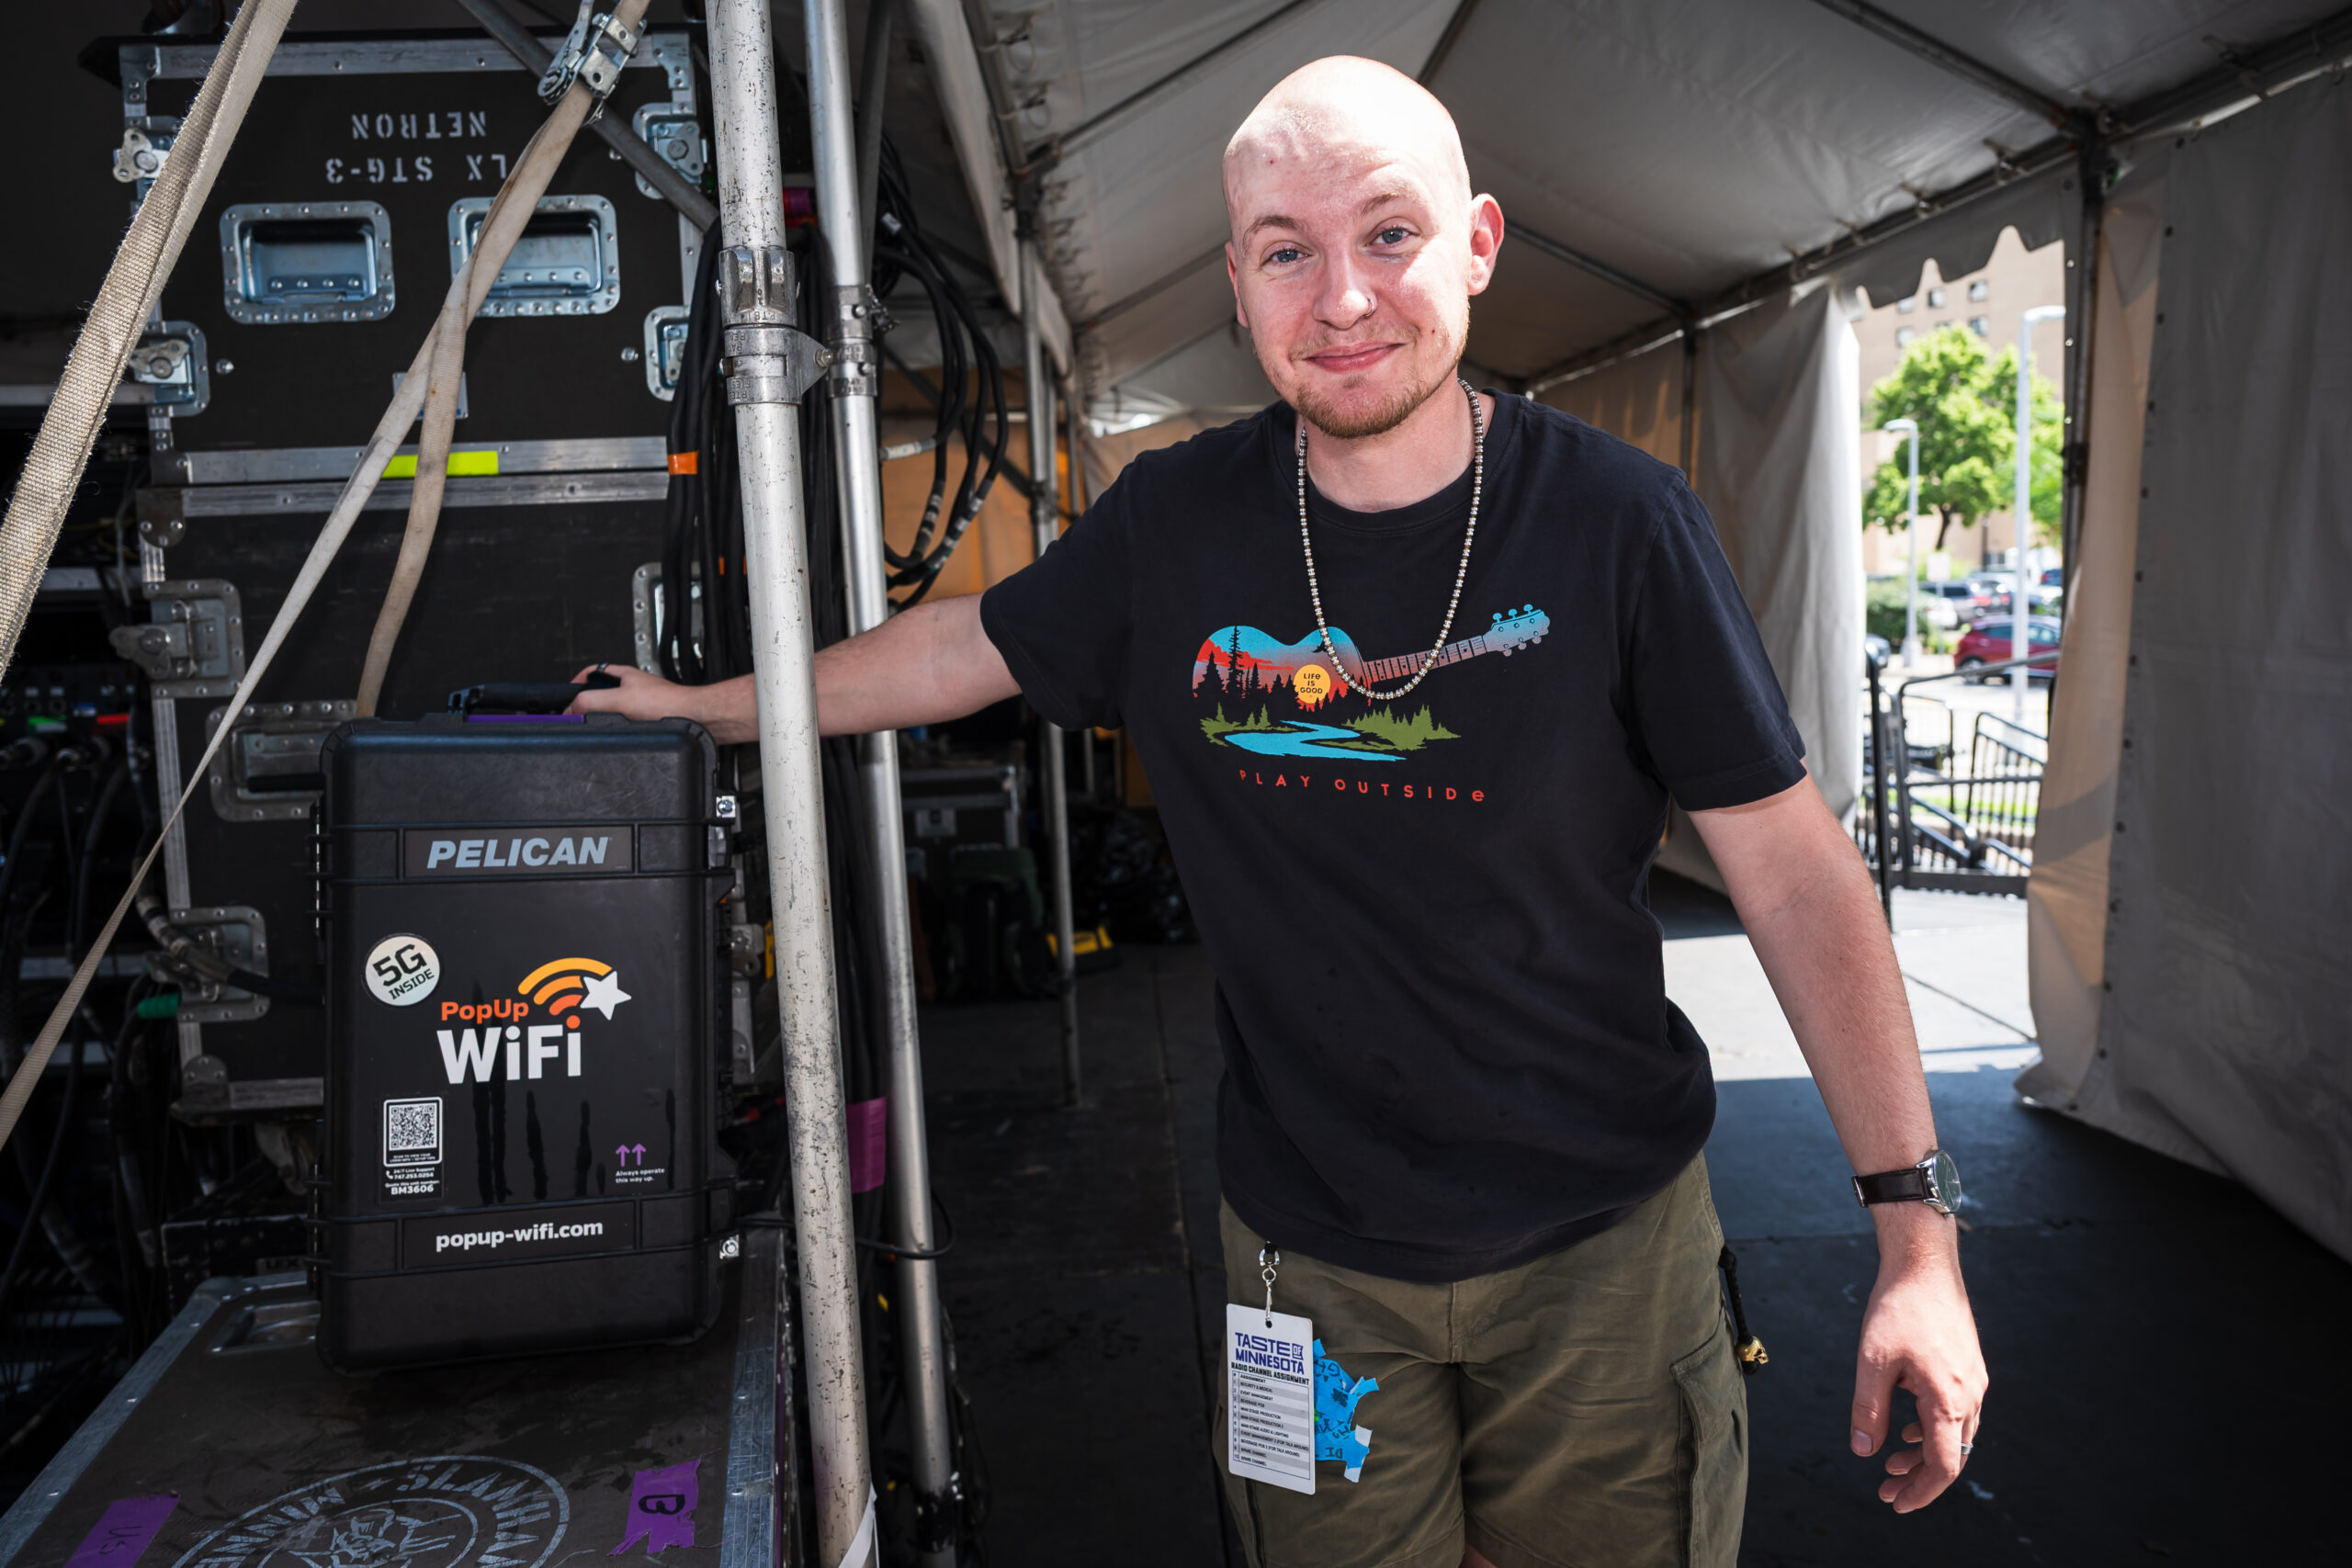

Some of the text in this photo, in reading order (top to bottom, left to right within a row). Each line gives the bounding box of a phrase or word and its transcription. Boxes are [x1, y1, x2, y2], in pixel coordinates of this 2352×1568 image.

[351, 111, 486, 139] NETRON
[325, 153, 506, 184] LX STG-3
[1239, 769, 1310, 787] PLAY
[426, 837, 609, 869] PELICAN
[372, 943, 427, 987] 5G
[388, 968, 435, 999] INSIDE
[441, 998, 529, 1024] PopUp
[436, 1015, 582, 1085] WiFi
[390, 1185, 434, 1195] BM3606
[436, 1222, 603, 1252] popup-wifi.com
[1235, 1332, 1303, 1358] TASTE OF
[1231, 1361, 1309, 1386] RADIO CHANNEL ASSIGNMENT
[1236, 1348, 1305, 1374] MINNESOTA
